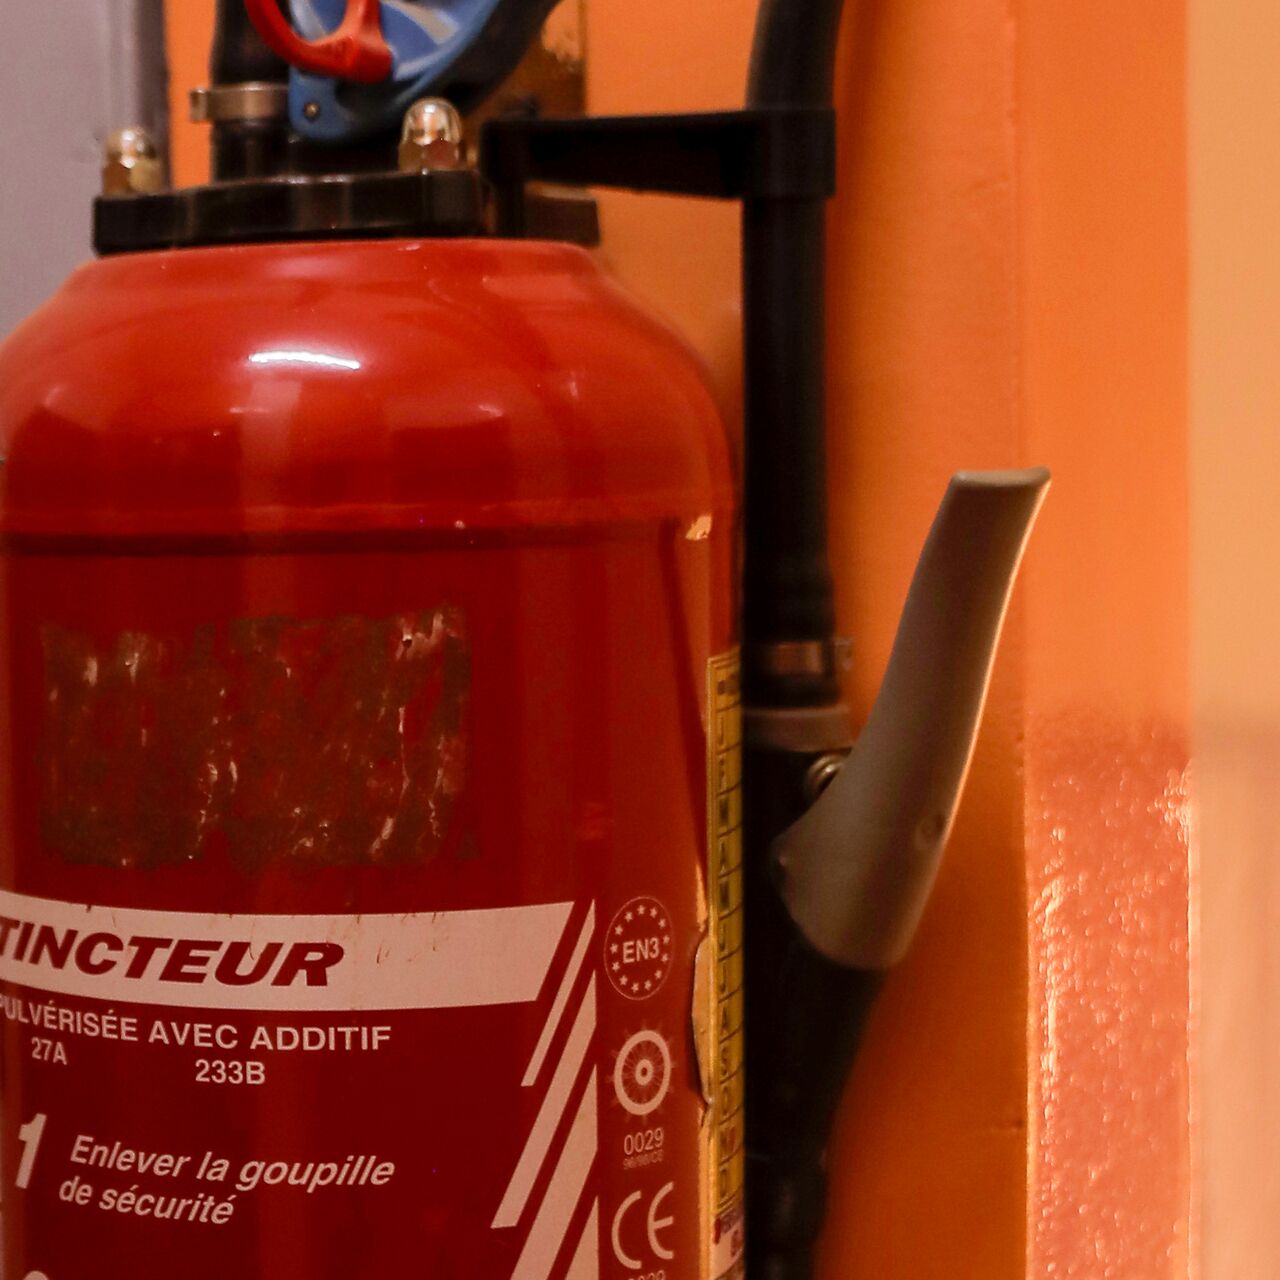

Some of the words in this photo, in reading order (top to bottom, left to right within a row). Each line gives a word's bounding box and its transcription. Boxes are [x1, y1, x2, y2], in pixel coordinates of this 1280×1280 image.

[622, 936, 660, 965] EN3
[149, 1021, 239, 1050] AVEC
[250, 1025, 392, 1052] ADDITIF
[31, 1037, 68, 1065] 27A
[195, 1060, 266, 1085] 233B
[16, 1114, 47, 1189] 1
[70, 1135, 190, 1177] Enlever
[196, 1151, 229, 1181] la
[235, 1156, 395, 1193] goupille
[624, 1127, 664, 1155] 0029
[59, 1176, 92, 1205] de
[99, 1185, 237, 1224] sécurité
[612, 1181, 674, 1270] CE
